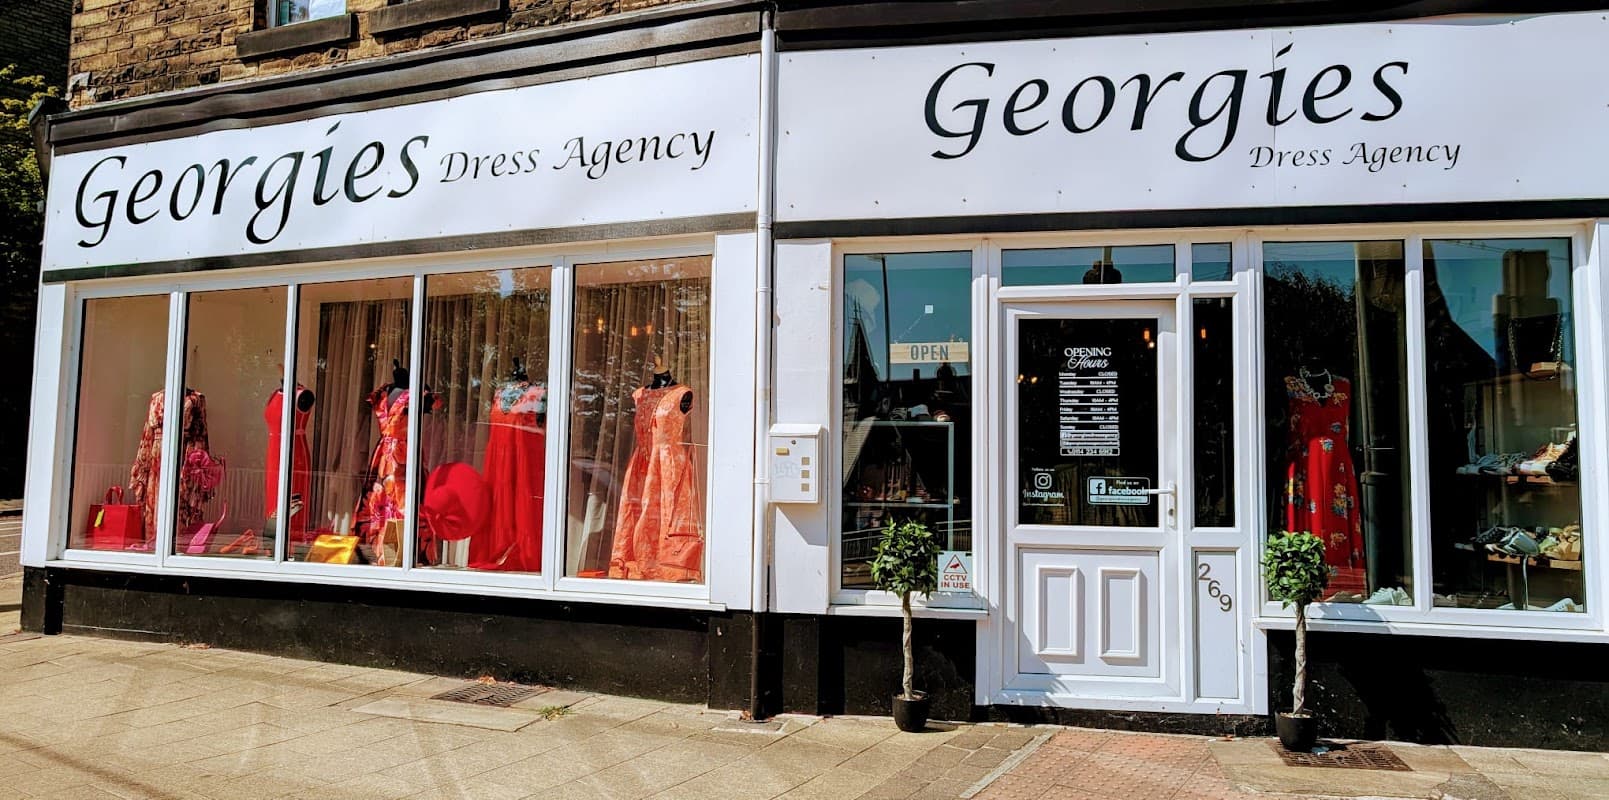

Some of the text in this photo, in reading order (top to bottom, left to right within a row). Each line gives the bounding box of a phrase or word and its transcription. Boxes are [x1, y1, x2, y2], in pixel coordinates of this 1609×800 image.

[924, 42, 1409, 163] Georgies
[1249, 141, 1461, 172] Dress Agency
[75, 120, 715, 248] Georgies Dress Agency
[911, 345, 949, 361] OPEN
[1064, 347, 1112, 357] OPENING
[1067, 355, 1110, 370] Hours
[1022, 489, 1065, 502] Instagram
[1198, 563, 1233, 612] 269
